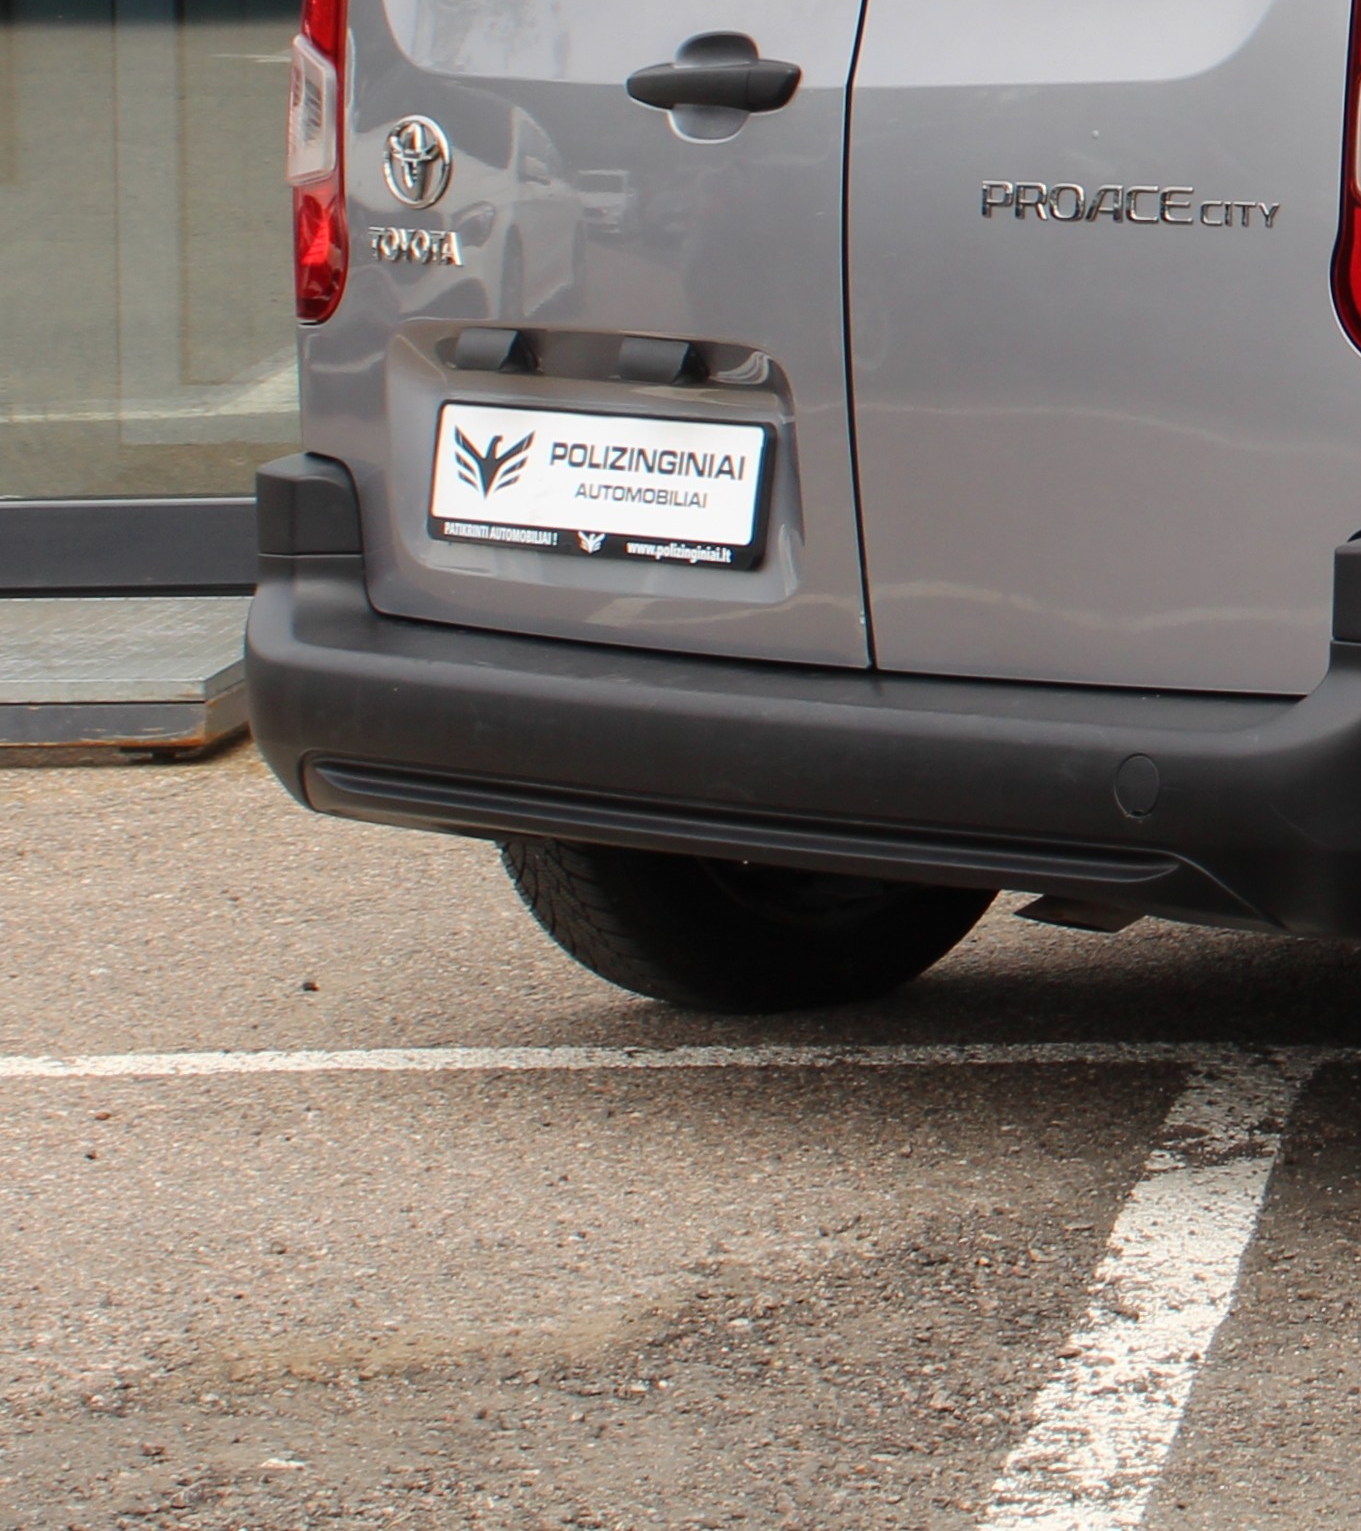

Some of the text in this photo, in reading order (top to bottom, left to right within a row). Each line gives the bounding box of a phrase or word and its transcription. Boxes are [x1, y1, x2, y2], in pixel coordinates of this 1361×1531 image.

[980, 180, 1280, 227] PROACE CITY
[368, 226, 464, 266] TOYOTA
[550, 442, 746, 481] POLIZINGINIAI
[575, 483, 708, 509] AUTOMOBILIAI
[444, 521, 489, 538] PATIKRINTI
[490, 526, 552, 546] AUTOMOBILIAI
[626, 542, 732, 564] www.polizinginiai.lt
